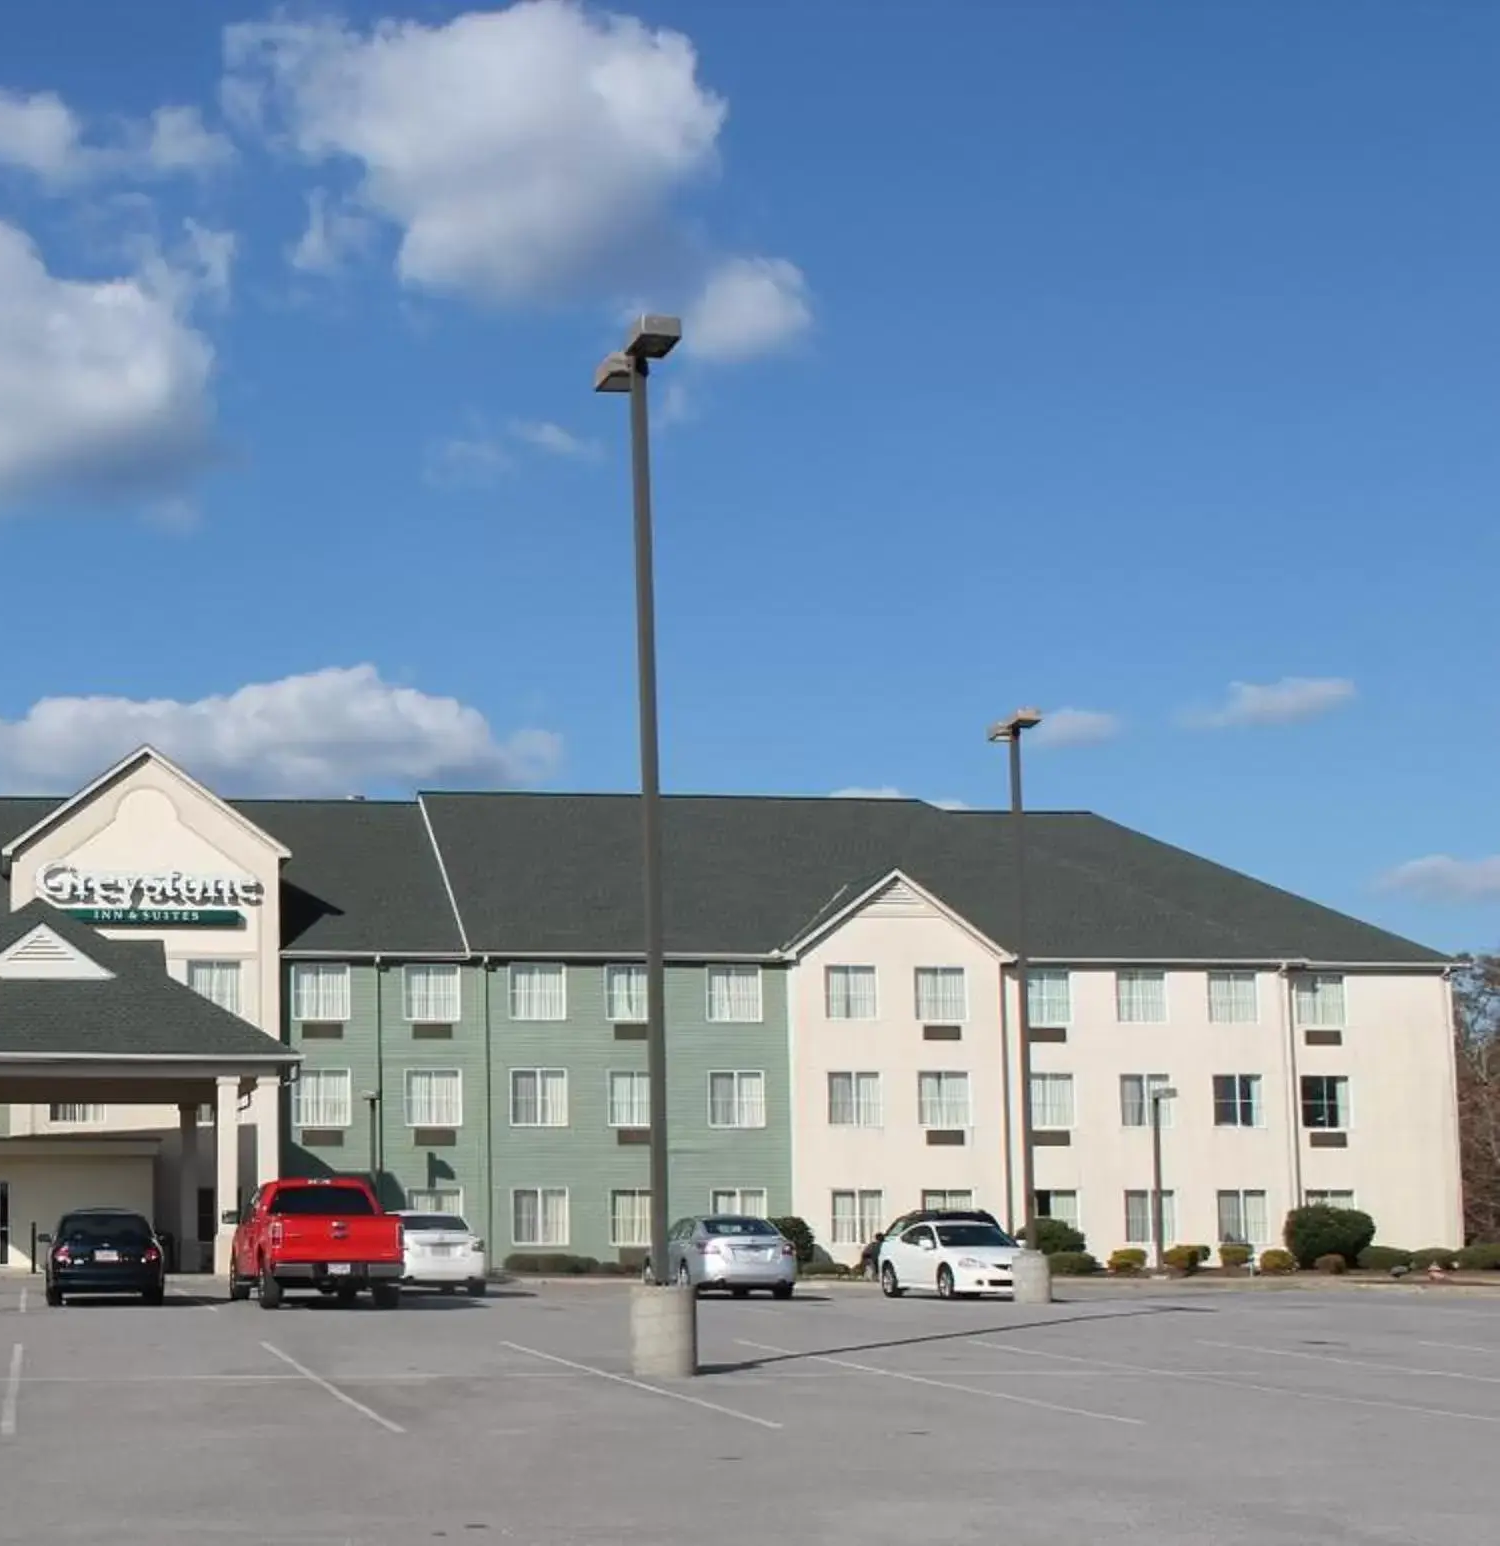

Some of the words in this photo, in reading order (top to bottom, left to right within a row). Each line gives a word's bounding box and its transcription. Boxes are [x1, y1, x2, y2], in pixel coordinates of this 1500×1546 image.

[37, 863, 264, 909] Greystone
[93, 909, 124, 920] INN
[128, 910, 138, 920] &
[141, 910, 200, 921] SUITES
